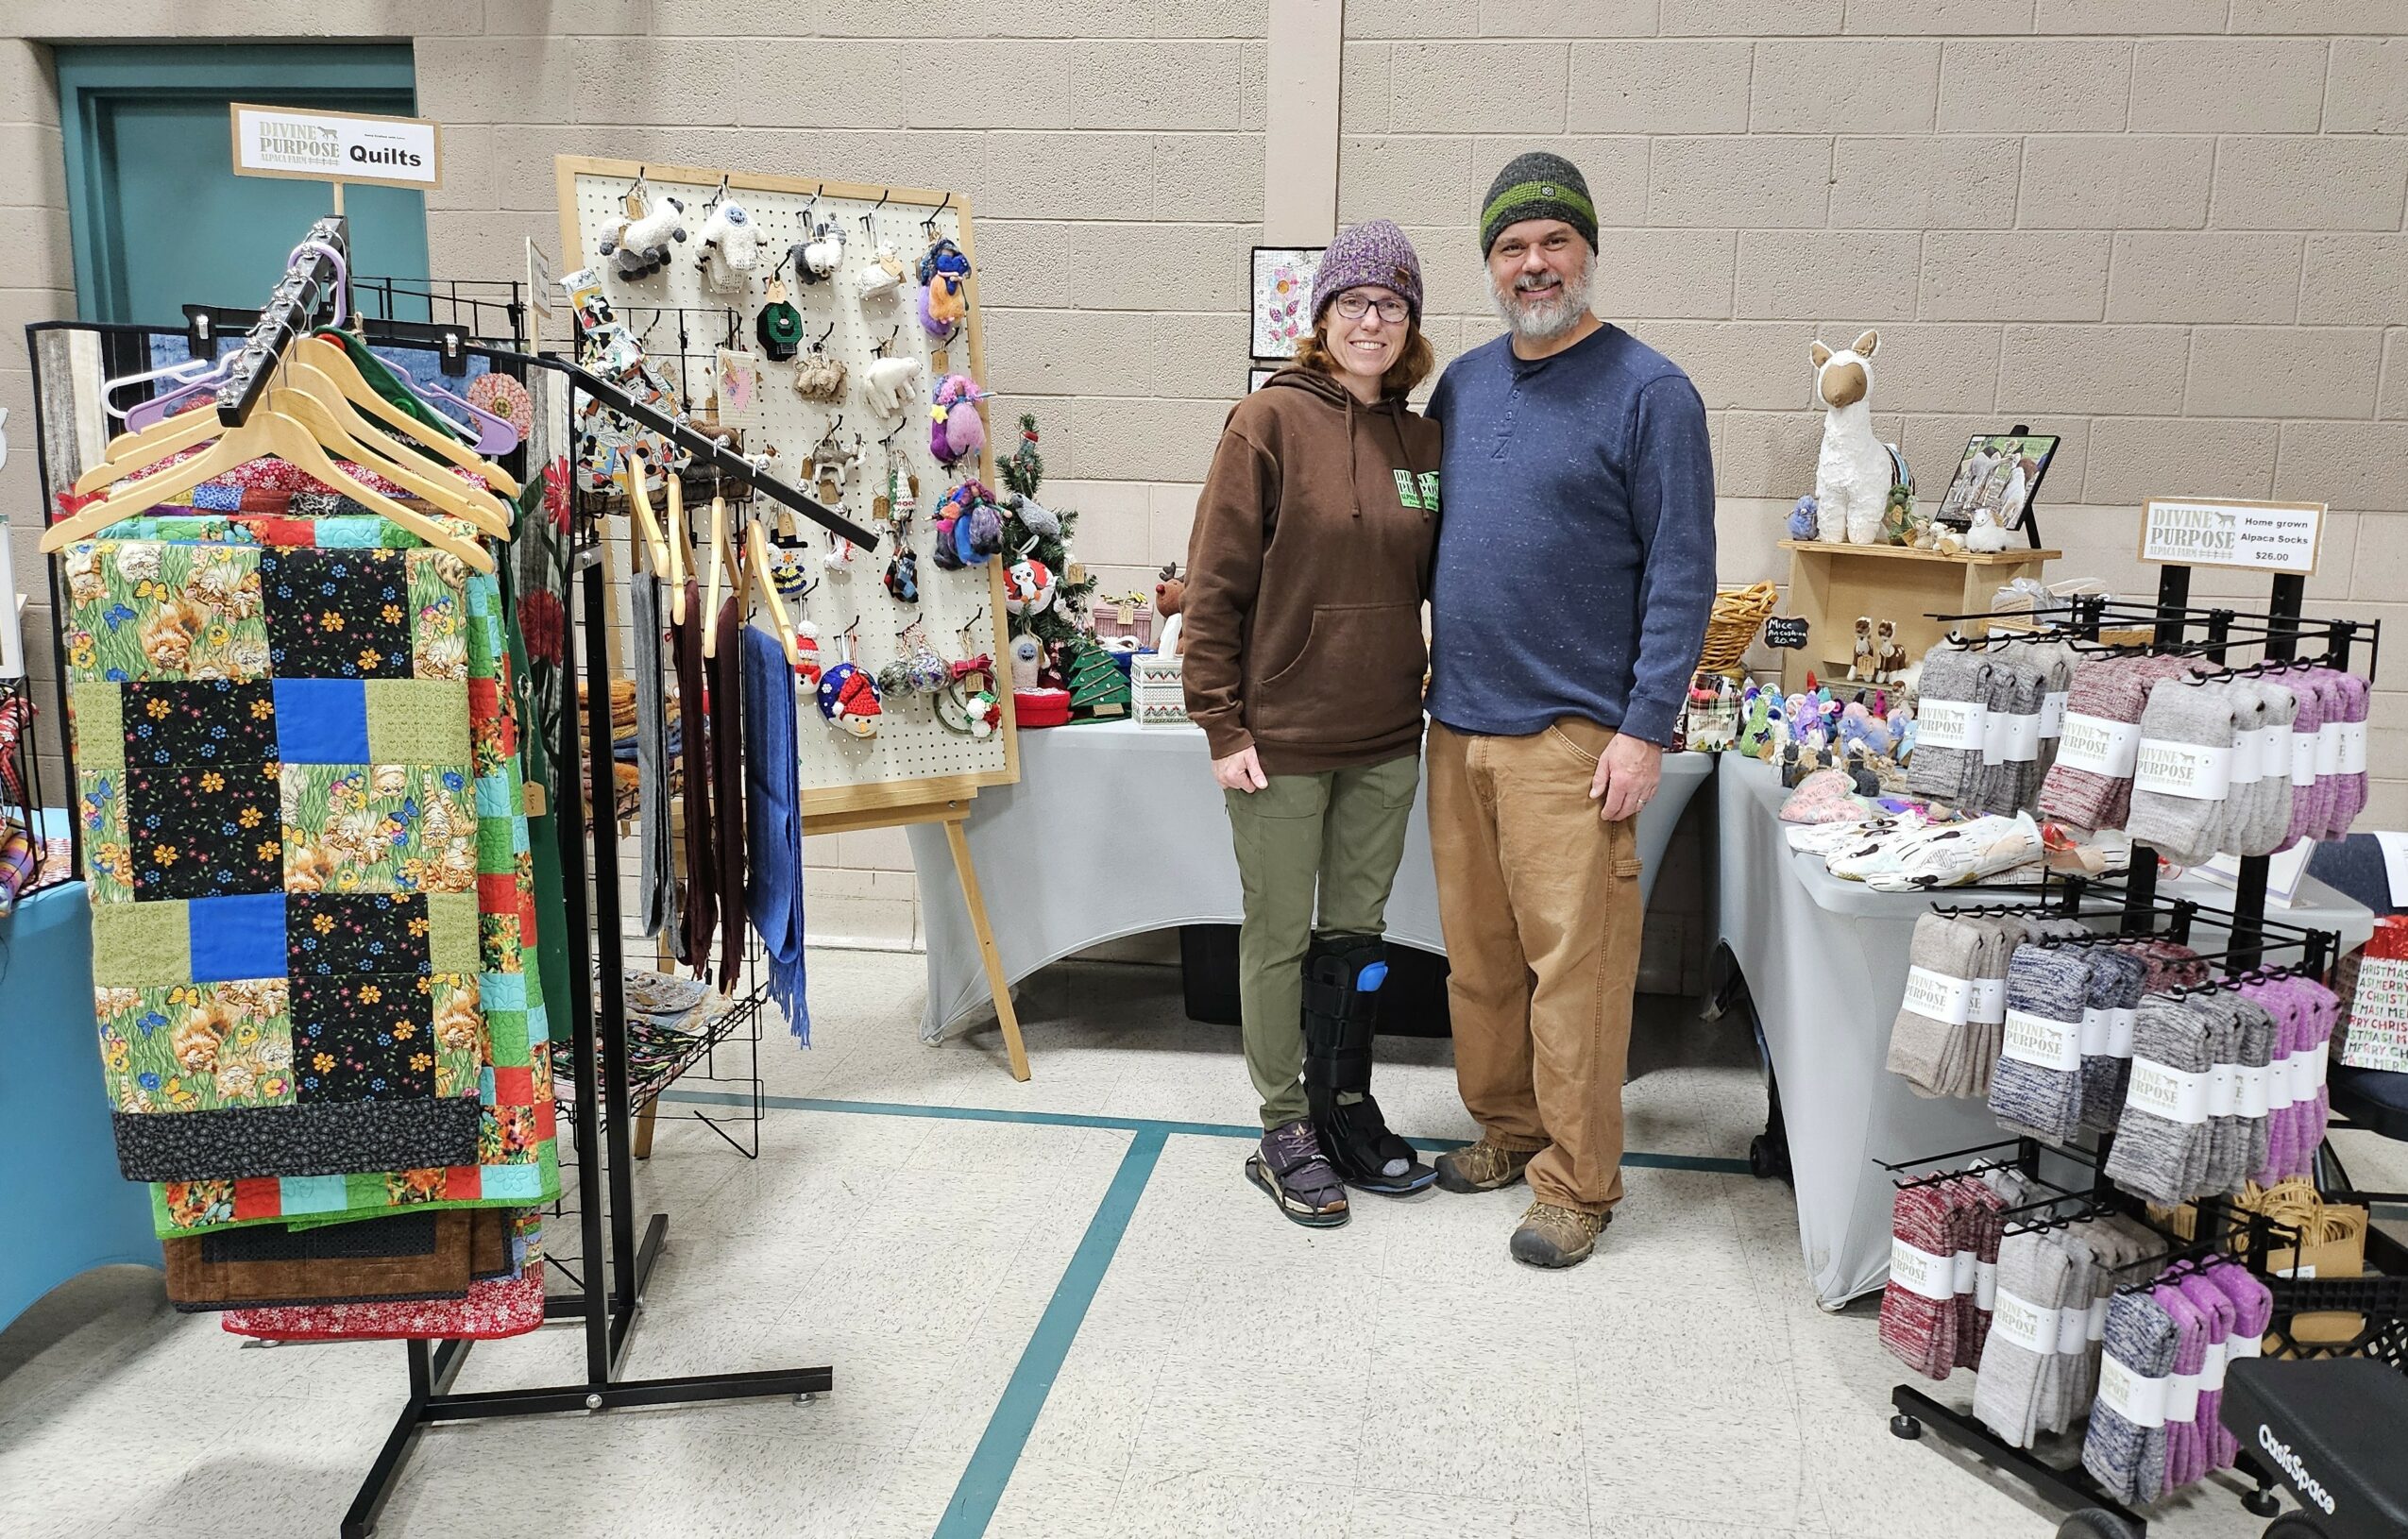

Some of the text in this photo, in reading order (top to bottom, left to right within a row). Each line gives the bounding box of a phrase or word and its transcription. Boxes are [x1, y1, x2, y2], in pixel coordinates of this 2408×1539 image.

[259, 121, 316, 140] DIVINE
[260, 138, 340, 158] PURPOSE
[350, 144, 422, 167] Quilts
[261, 153, 308, 166] ALPACA FARM
[2153, 508, 2213, 529] DIVINE
[2245, 517, 2308, 529] Home grown
[2149, 527, 2236, 550] PURPOSE
[2240, 533, 2309, 545] Alpaca Socks
[2149, 546, 2197, 558] ALPACA FARM
[1768, 618, 1792, 630] Mice
[2139, 746, 2179, 764] DIVINE
[2136, 760, 2196, 780] PURPOSE
[2008, 1018, 2045, 1039] DIVINE
[2006, 1030, 2062, 1055] PURPOSE
[2259, 1424, 2335, 1514] OasisSpace
